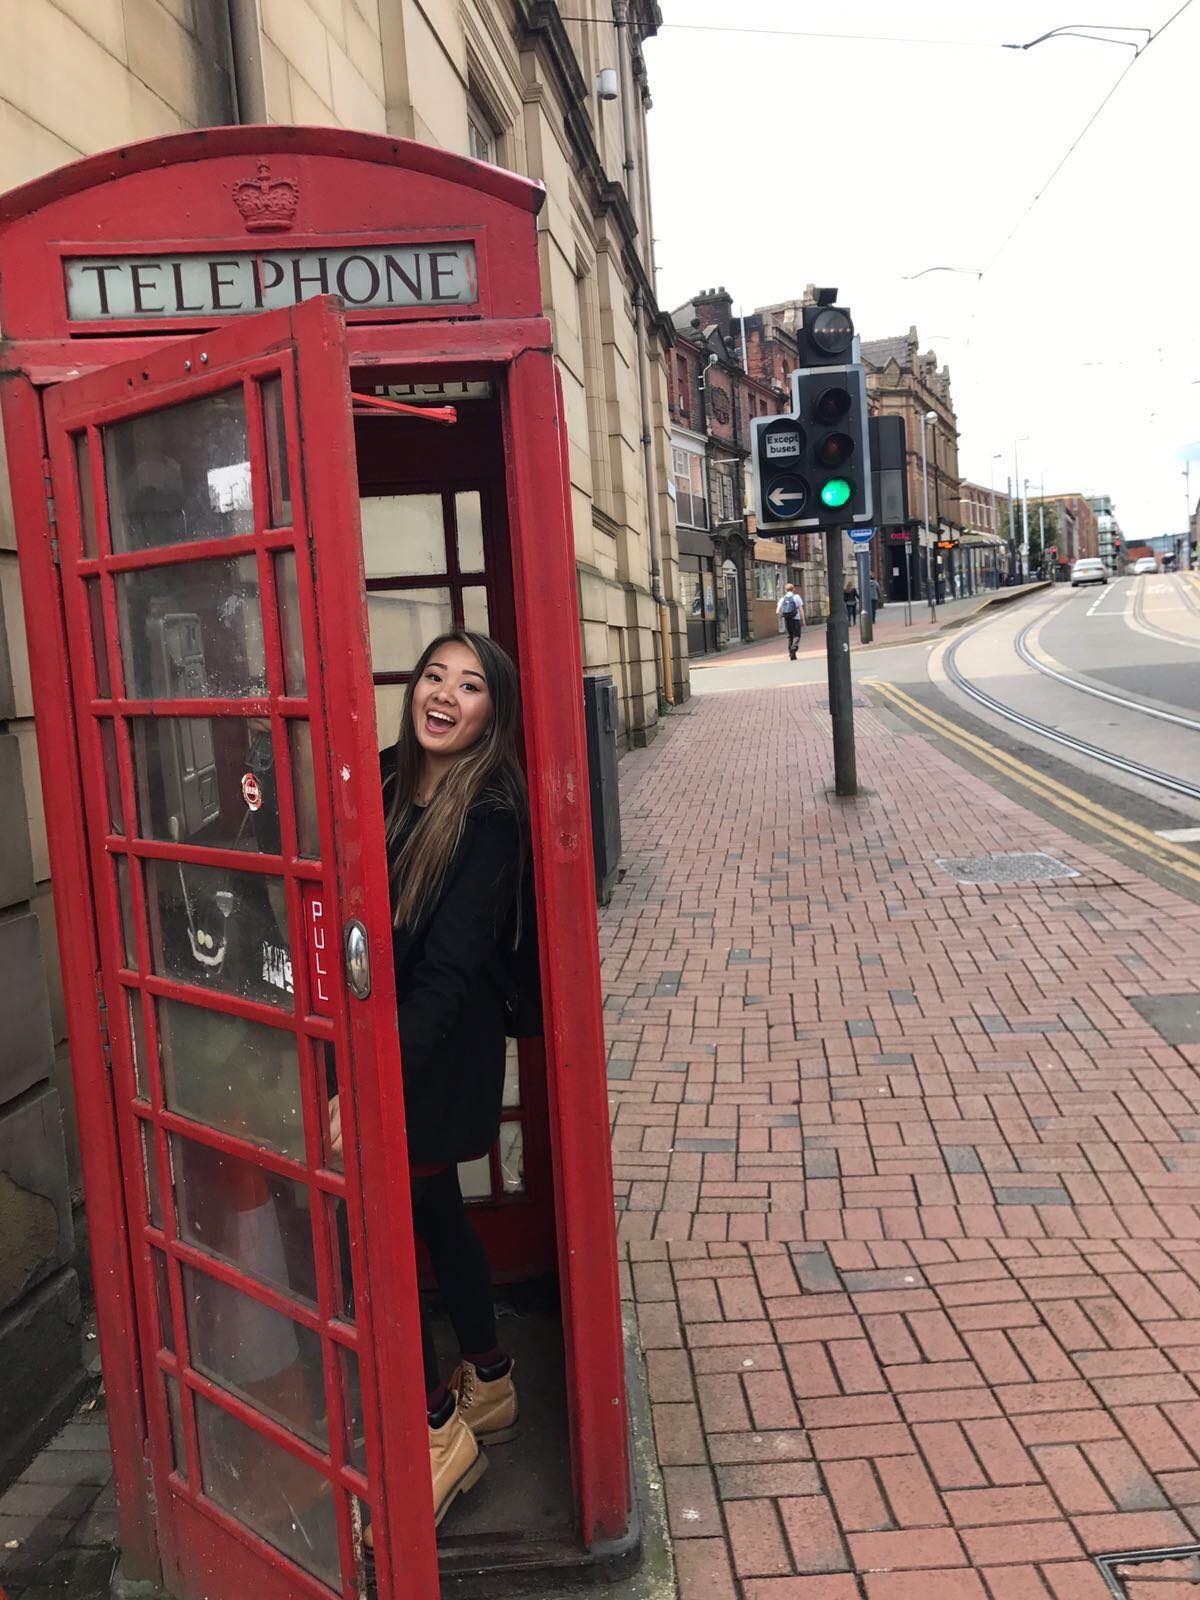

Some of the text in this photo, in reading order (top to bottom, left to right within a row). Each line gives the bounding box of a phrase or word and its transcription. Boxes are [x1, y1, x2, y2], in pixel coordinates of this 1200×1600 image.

[81, 251, 462, 315] TELEPHONE
[767, 434, 798, 444] Except
[770, 445, 796, 453] buses
[312, 901, 329, 1000] PULL
